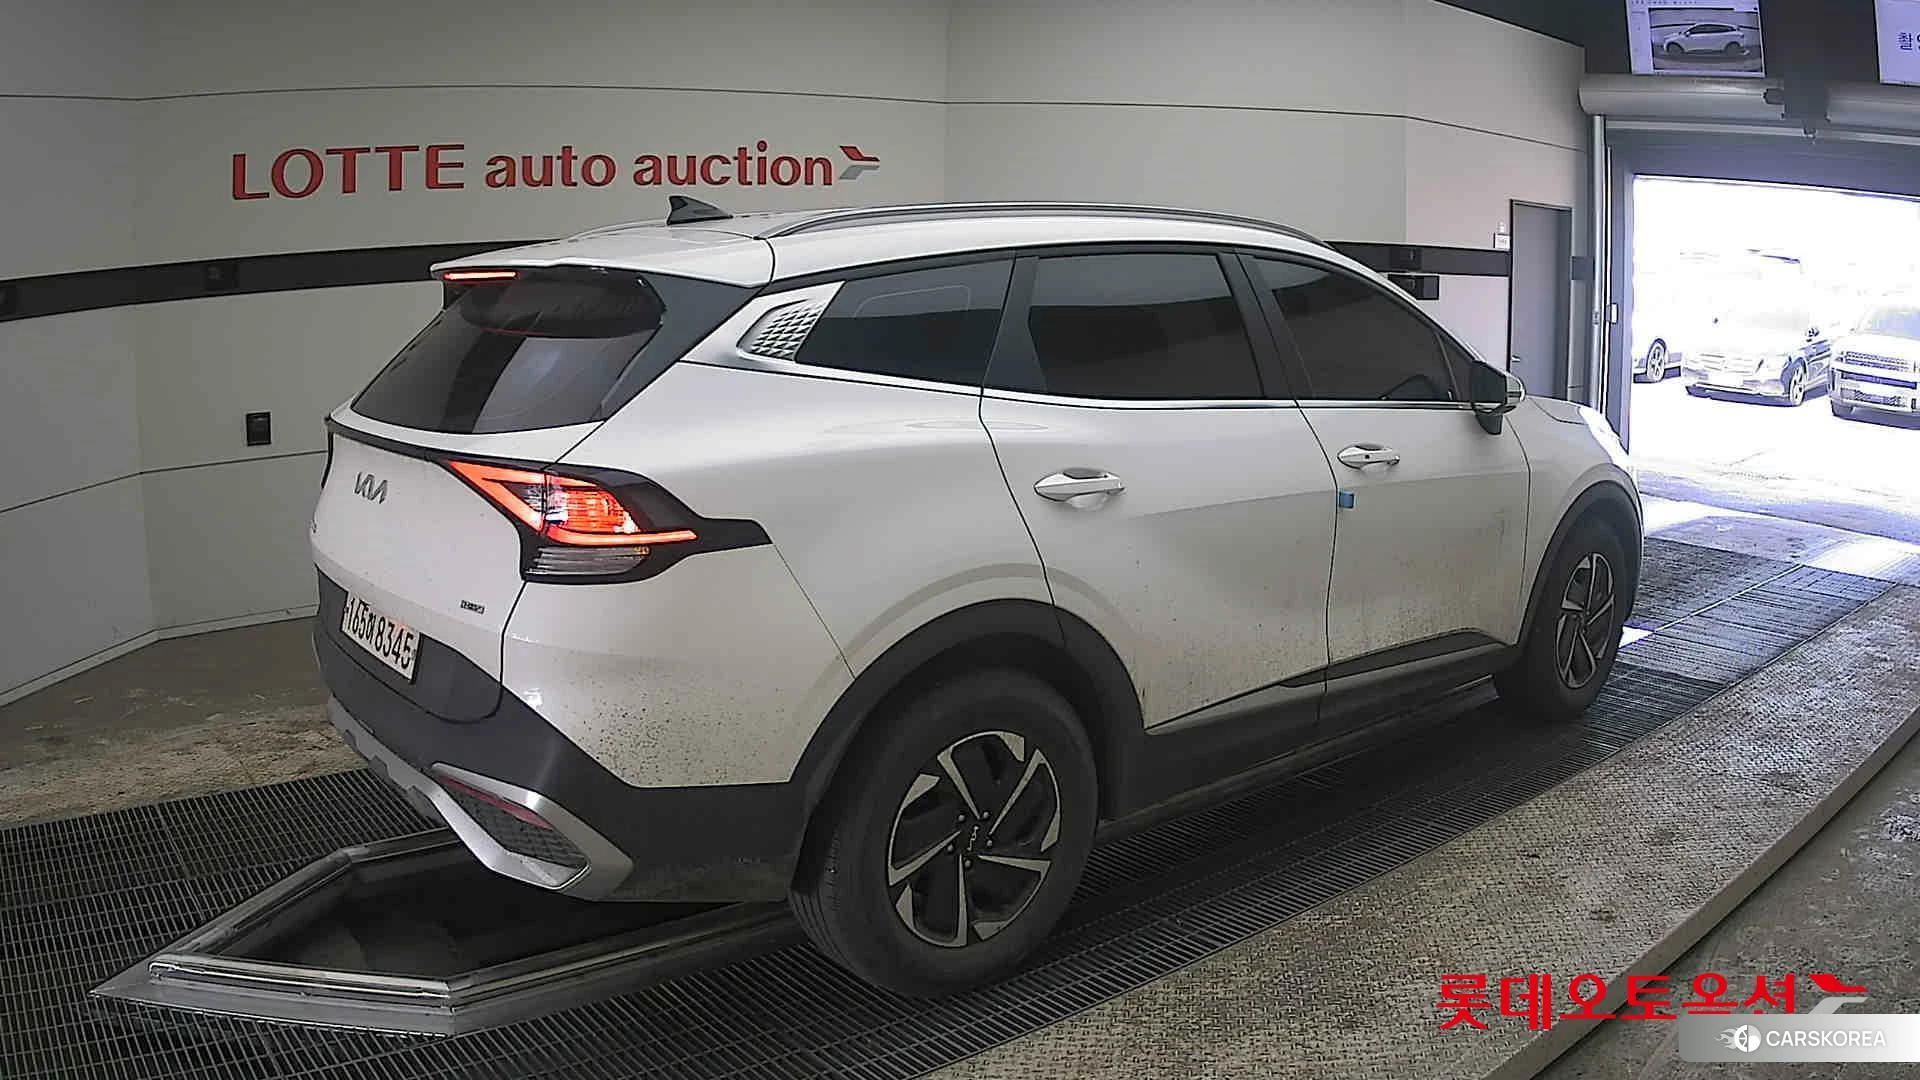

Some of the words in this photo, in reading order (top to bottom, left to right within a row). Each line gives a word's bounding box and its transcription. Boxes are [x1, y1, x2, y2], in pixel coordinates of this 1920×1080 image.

[231, 144, 466, 200] LOTTE
[485, 144, 617, 188] auto
[632, 140, 834, 187] auction
[354, 471, 388, 505] KIA
